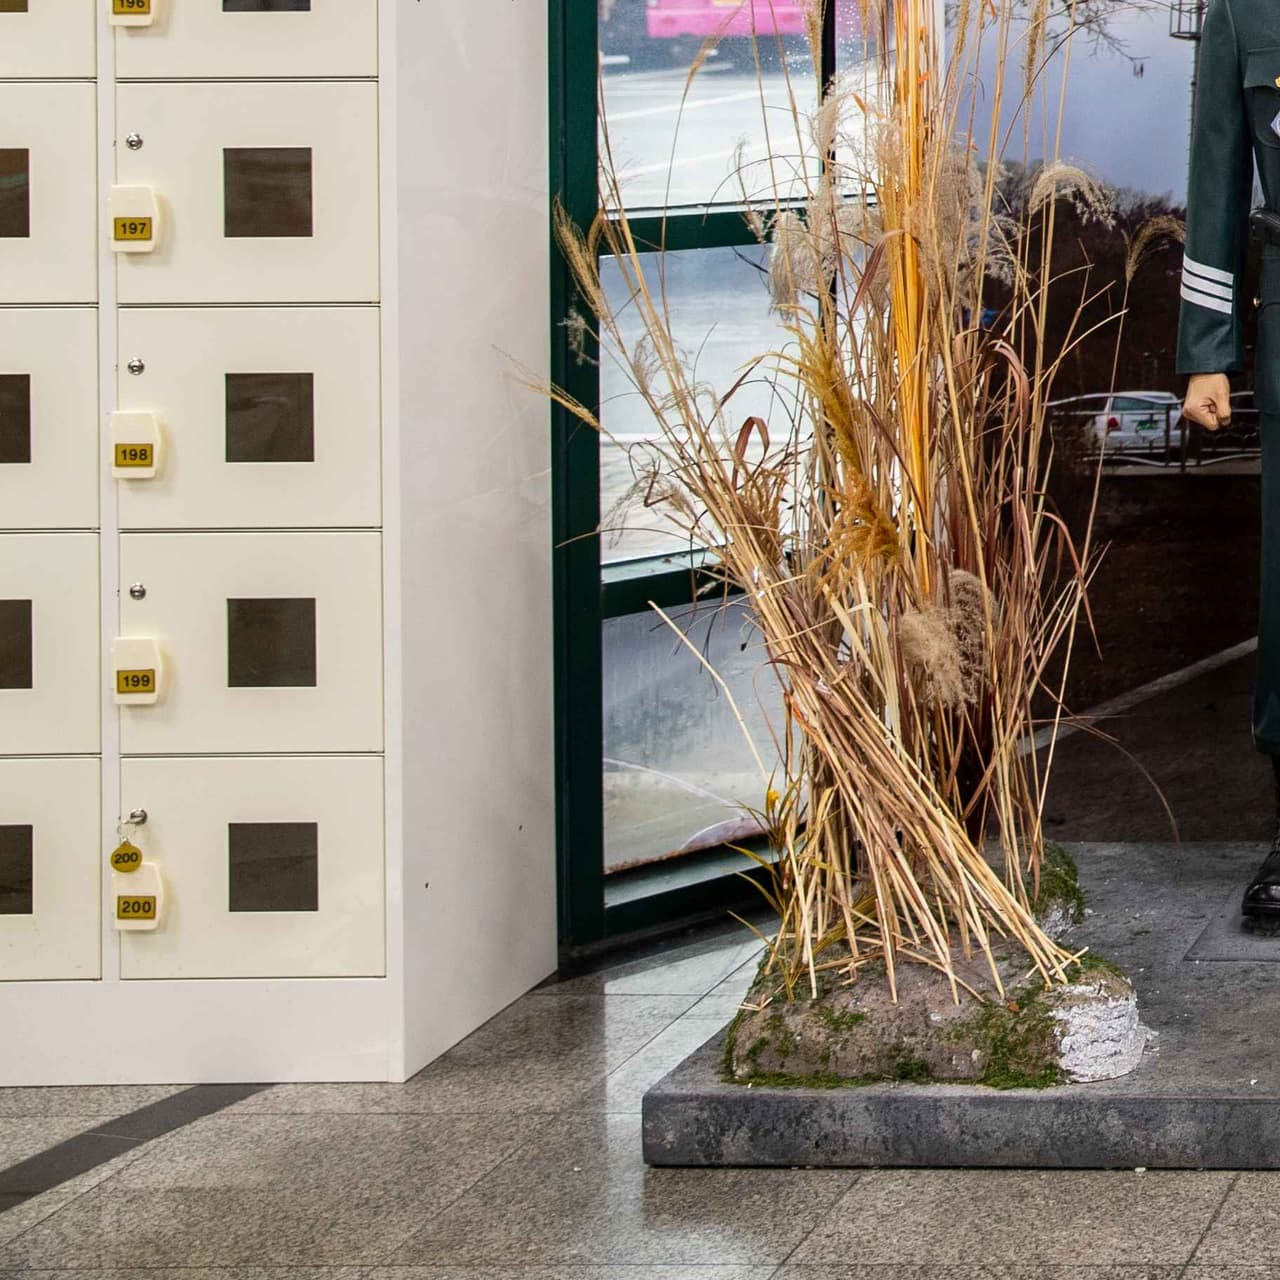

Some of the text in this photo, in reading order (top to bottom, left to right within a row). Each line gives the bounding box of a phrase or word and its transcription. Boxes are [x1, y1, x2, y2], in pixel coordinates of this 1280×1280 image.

[120, 222, 148, 236] 197
[120, 448, 149, 462] 198
[122, 674, 151, 689] 199
[114, 851, 140, 866] 200
[121, 900, 153, 915] 200
